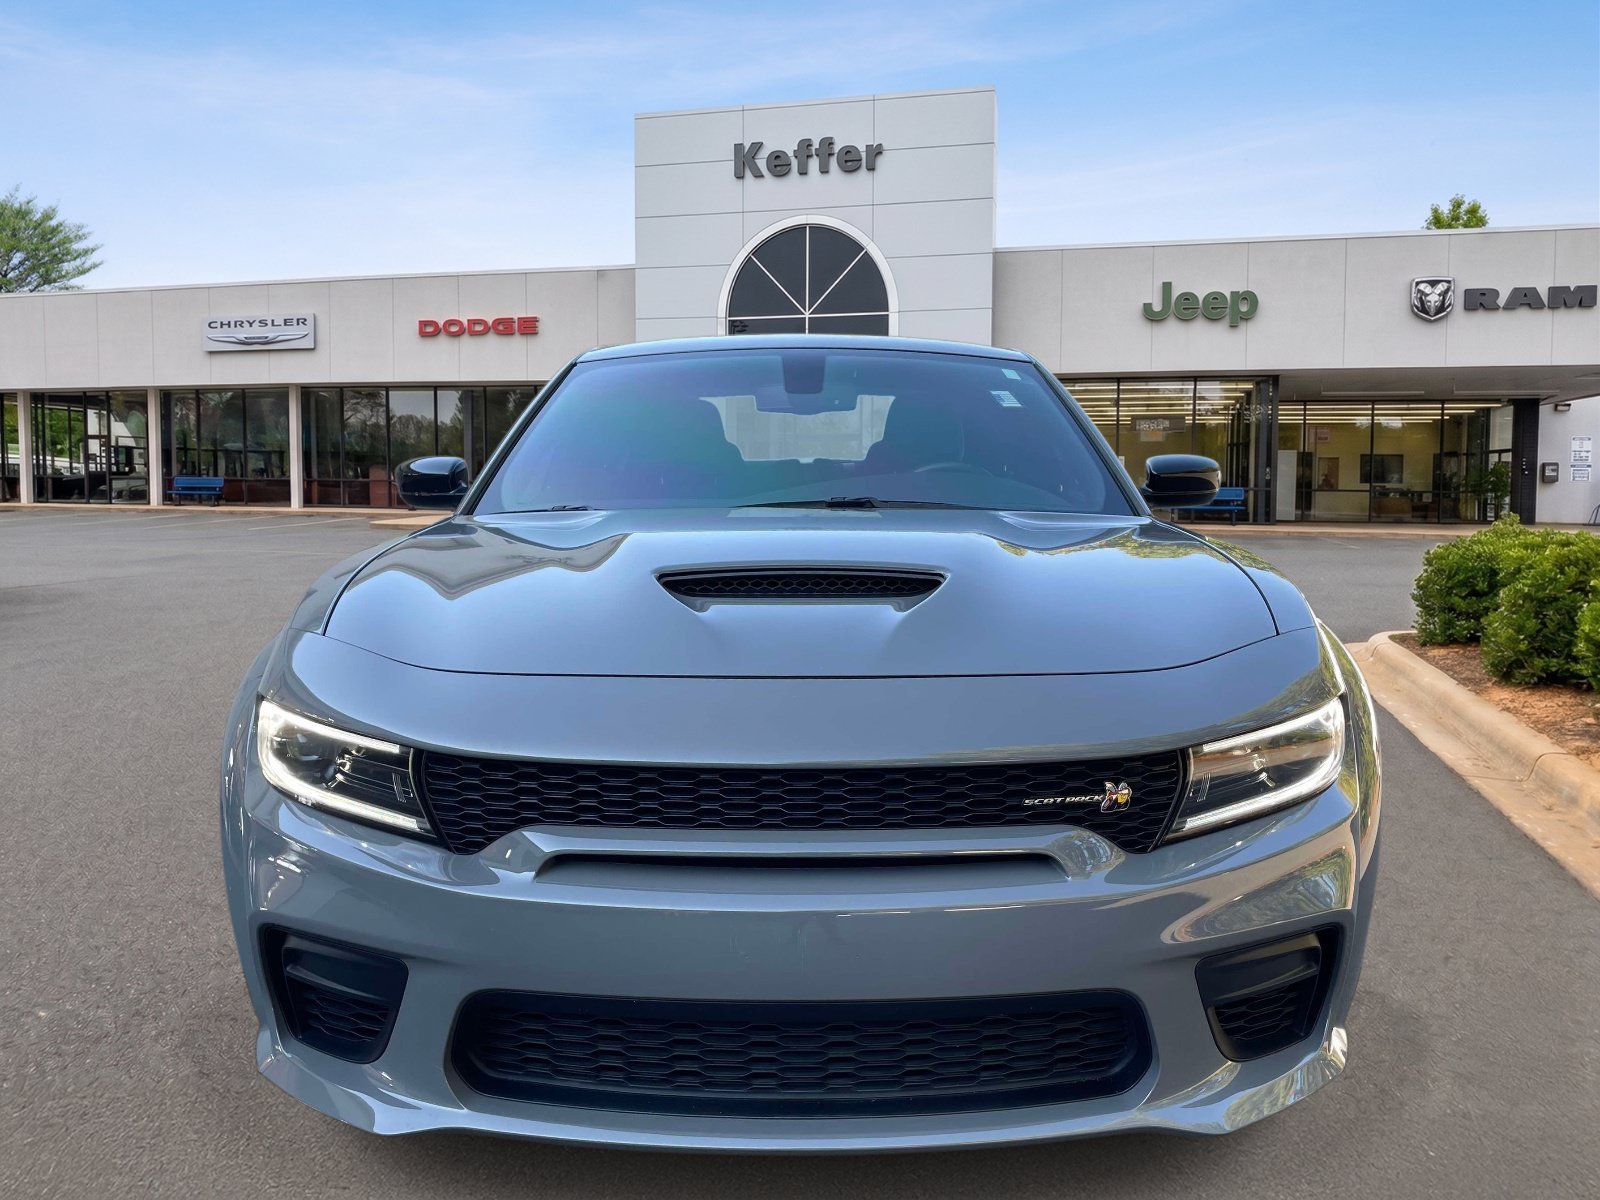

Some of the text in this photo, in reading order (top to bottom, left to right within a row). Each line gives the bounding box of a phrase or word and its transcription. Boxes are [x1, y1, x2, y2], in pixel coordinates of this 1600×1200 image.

[733, 136, 883, 178] Keffer
[1142, 281, 1259, 327] Jeep
[1464, 284, 1598, 310] RAM
[207, 317, 308, 329] CHRYSLER
[418, 316, 539, 337] DODGE
[1023, 797, 1065, 806] SCAT
